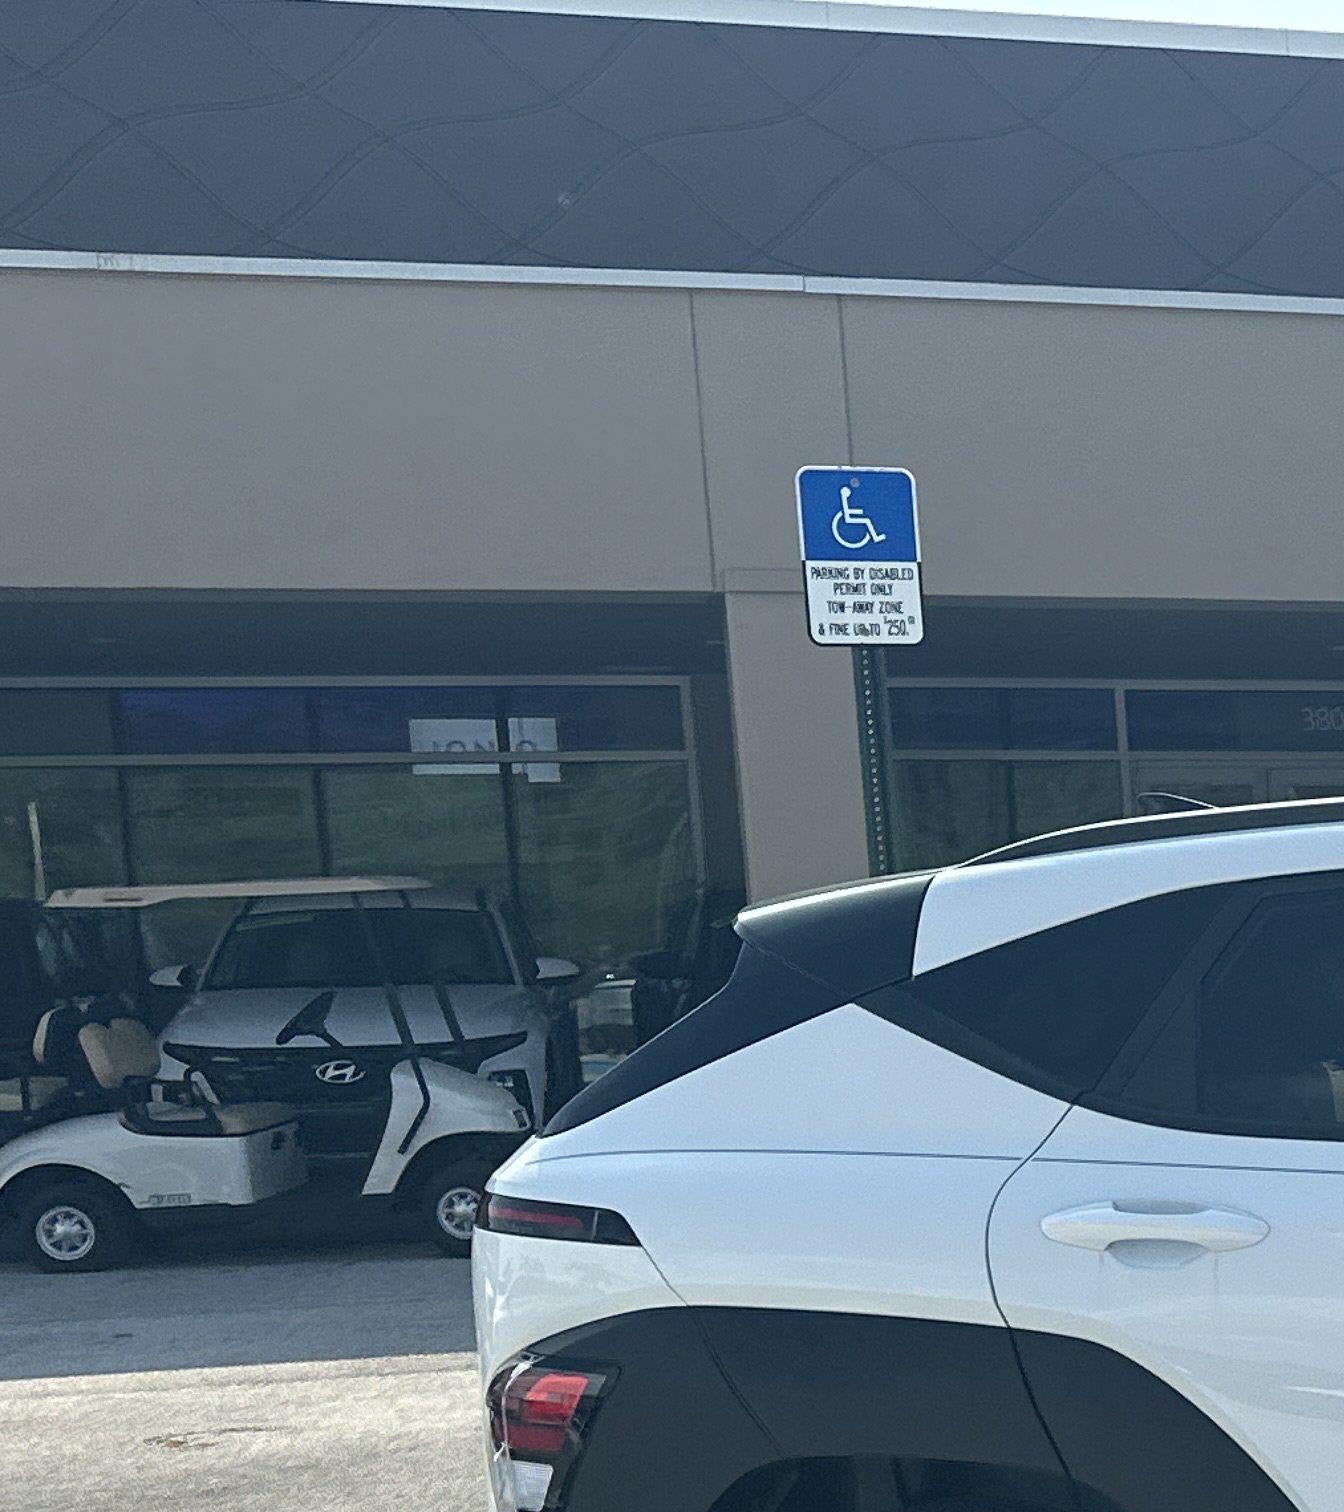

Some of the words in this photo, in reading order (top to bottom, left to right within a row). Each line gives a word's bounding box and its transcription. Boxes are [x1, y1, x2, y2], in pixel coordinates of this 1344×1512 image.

[811, 567, 850, 580] PARKING
[853, 568, 865, 580] BY
[869, 568, 914, 580] DISABLED
[833, 583, 866, 595] PERMIT
[871, 583, 893, 596] ONLY
[827, 600, 874, 614] TOW-AWAY
[879, 601, 904, 614] ZONE
[819, 623, 825, 636] &
[829, 623, 850, 636] FINE
